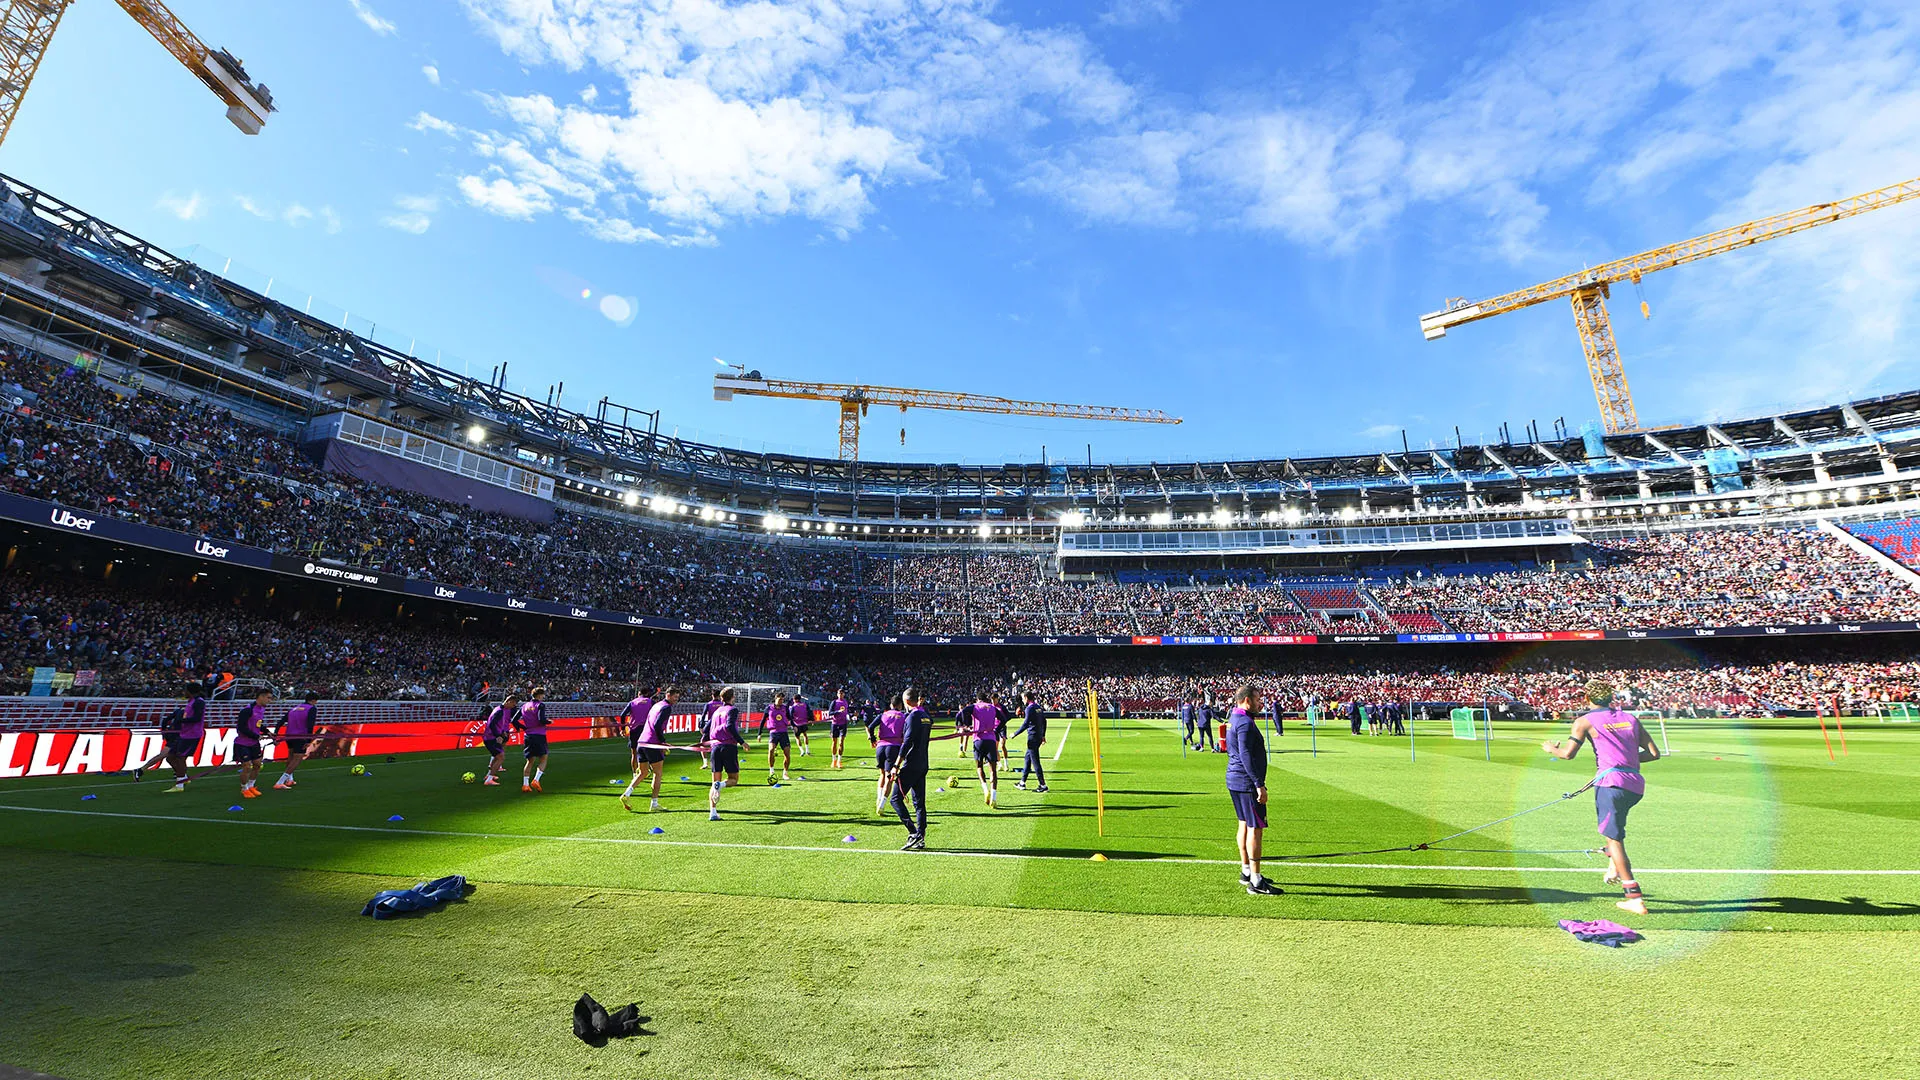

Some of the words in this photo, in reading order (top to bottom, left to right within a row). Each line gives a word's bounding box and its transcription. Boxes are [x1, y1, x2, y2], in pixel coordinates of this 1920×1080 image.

[50, 508, 95, 531] Uber
[194, 540, 229, 558] Uber
[315, 566, 344, 577] SPOTIFY
[344, 572, 364, 581] CAMP
[364, 575, 378, 584] NOU
[434, 586, 456, 599] Uber
[507, 598, 526, 609] Uber
[571, 607, 588, 618] Uber
[628, 616, 644, 625] Uber
[680, 622, 694, 631] Uber
[1766, 626, 1786, 635] Uber
[1839, 624, 1860, 632] Uber
[728, 627, 742, 636] Uber
[776, 631, 791, 640] Uber
[1513, 632, 1544, 640] BARCELONA
[1696, 628, 1715, 637] Uber
[828, 634, 844, 642] Uber
[1266, 635, 1294, 643] BARCELONA
[663, 714, 693, 734] ELLA
